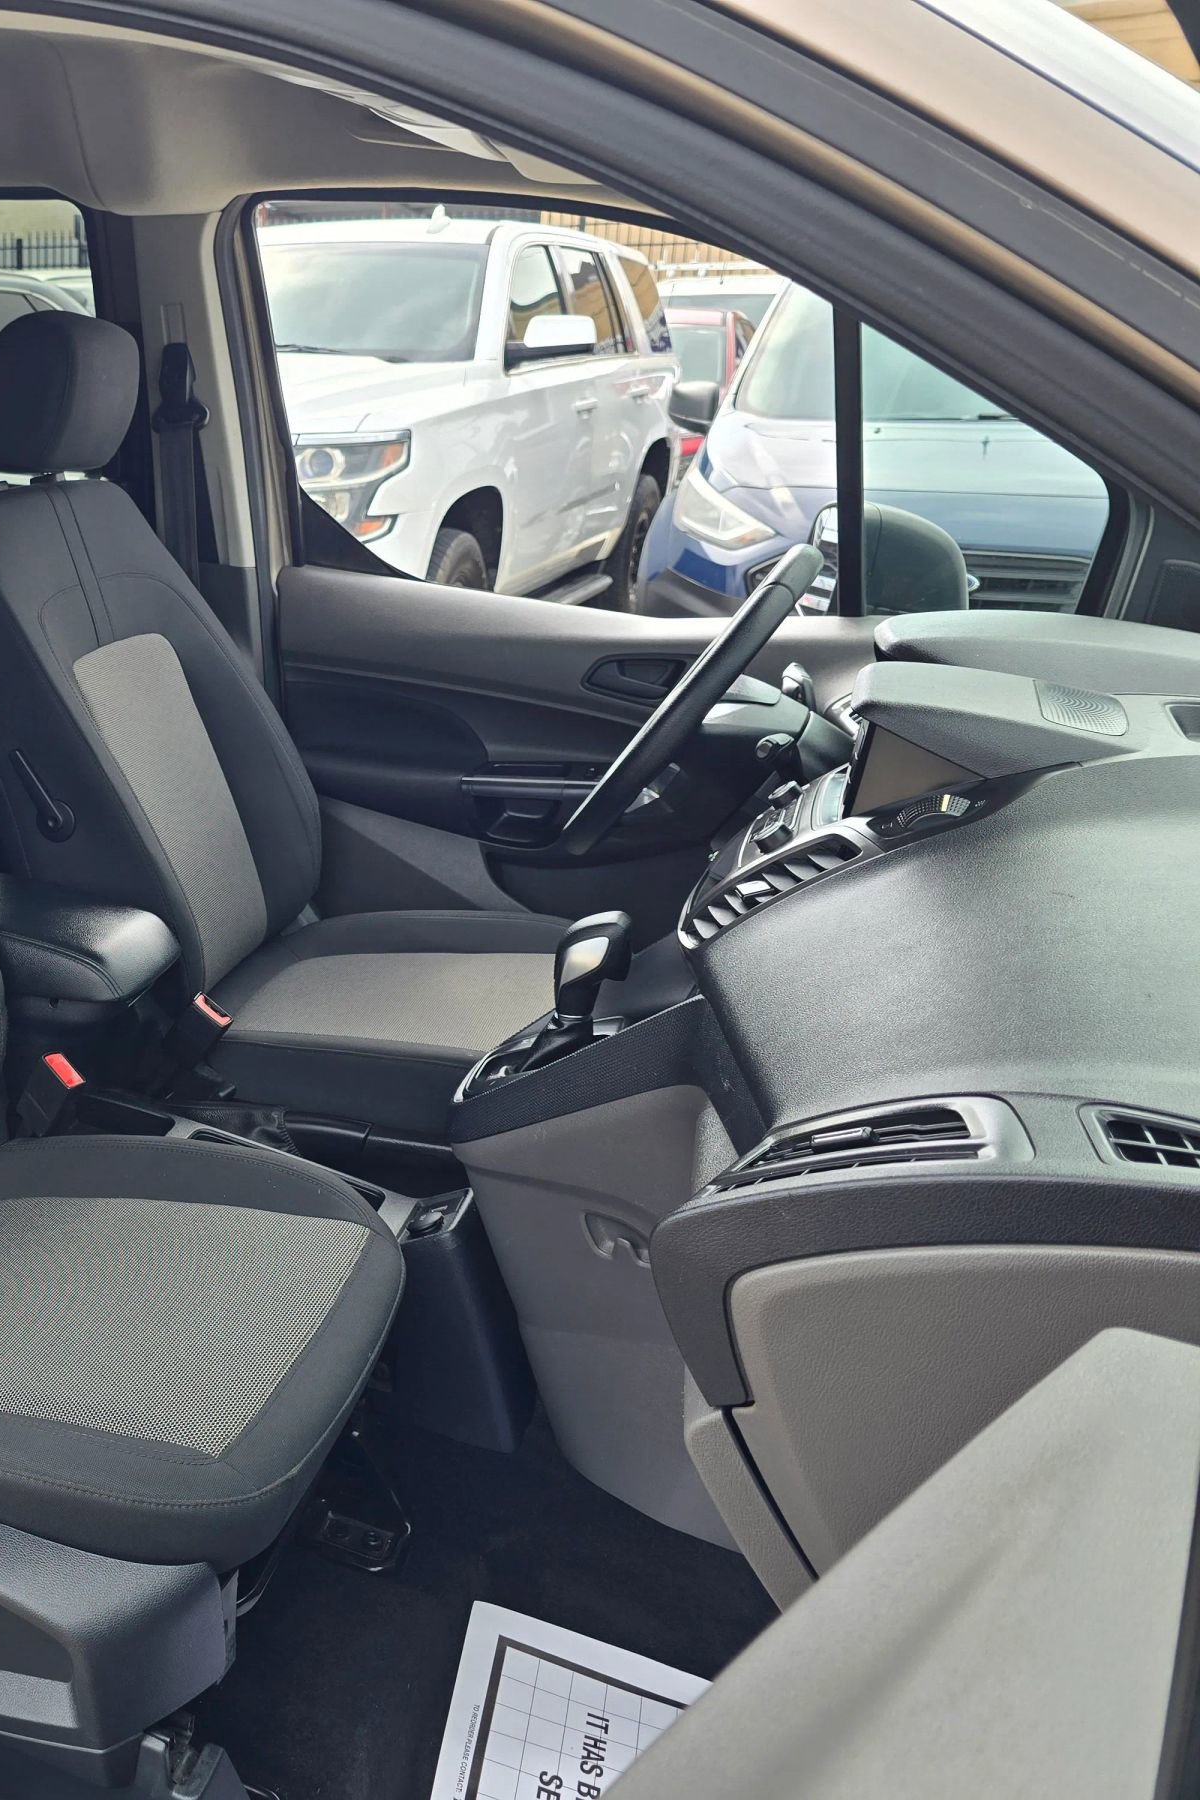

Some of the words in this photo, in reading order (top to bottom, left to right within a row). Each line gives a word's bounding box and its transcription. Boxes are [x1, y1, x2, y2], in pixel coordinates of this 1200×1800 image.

[472, 1704, 481, 1712] TO
[467, 1712, 478, 1740] REORDER
[586, 1712, 610, 1735] IT
[462, 1738, 473, 1761] PLEASE
[580, 1734, 607, 1778] HAS
